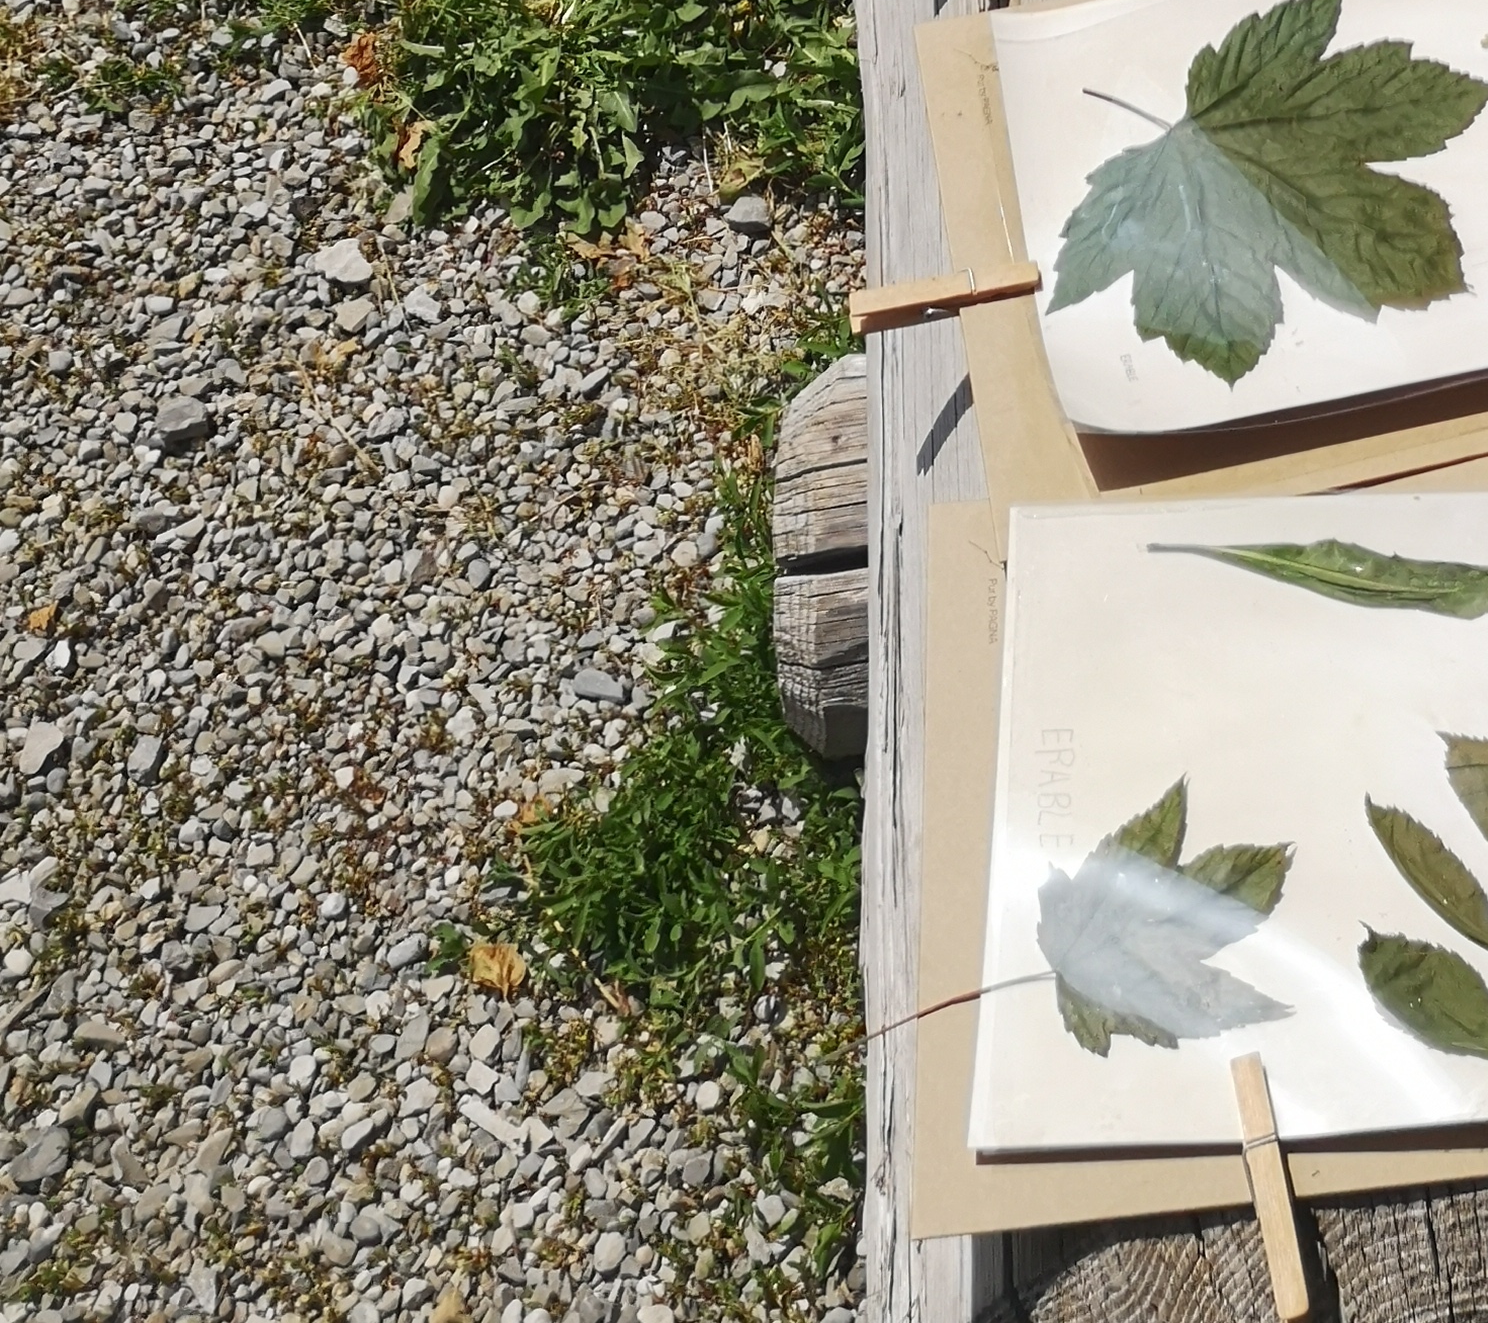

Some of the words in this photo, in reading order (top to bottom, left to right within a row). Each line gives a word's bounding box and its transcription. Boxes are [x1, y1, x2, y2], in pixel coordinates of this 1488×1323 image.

[986, 595, 998, 609] by
[988, 609, 999, 645] PAGNA
[1034, 728, 1077, 849] ERABLE
